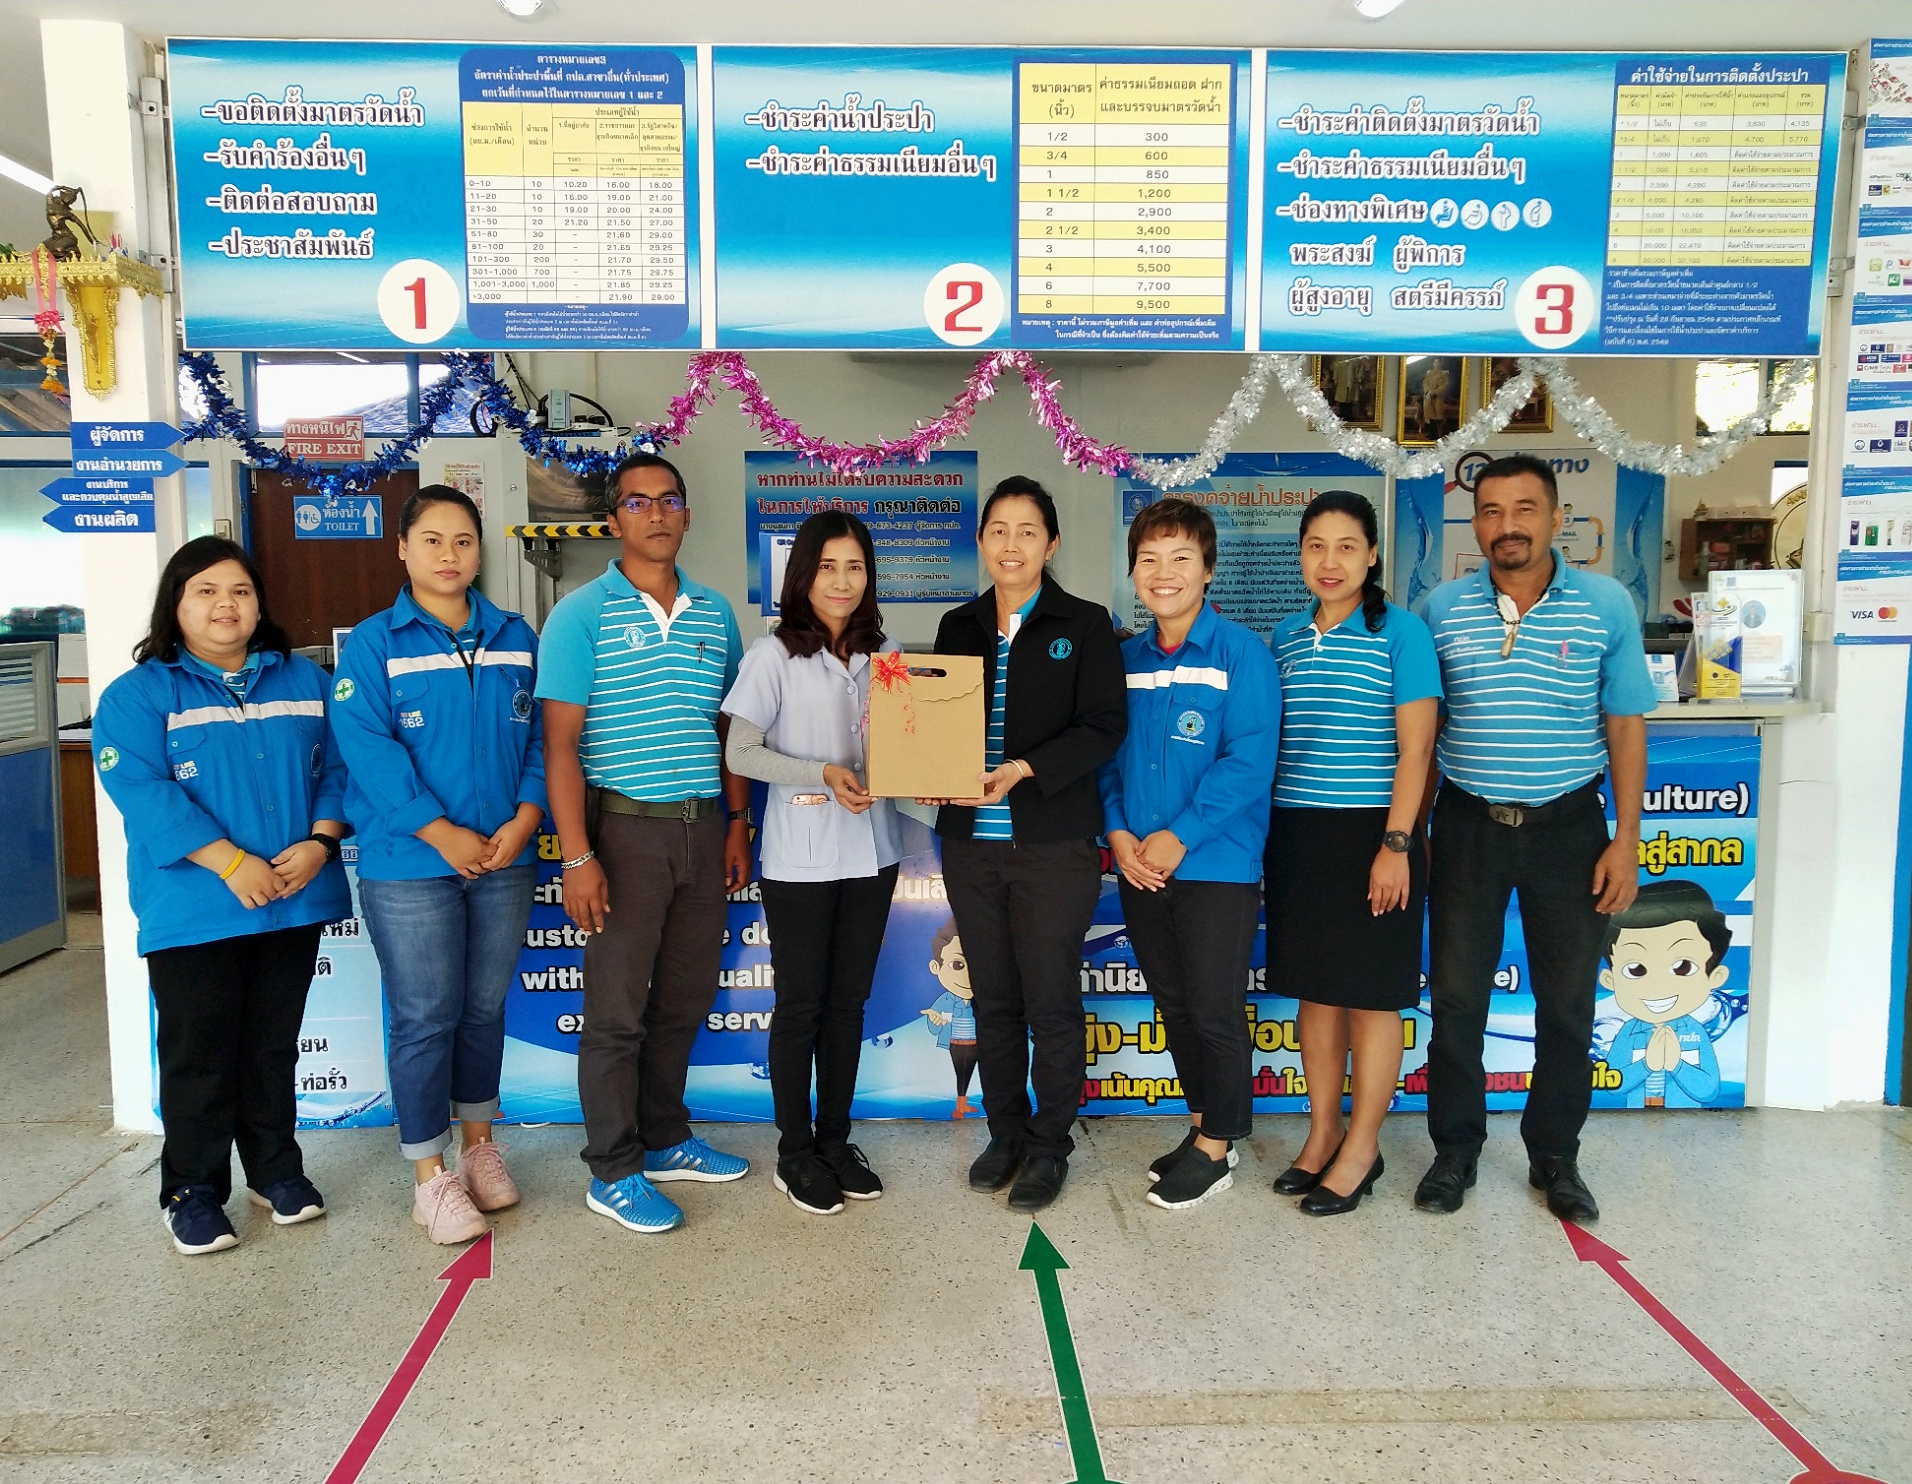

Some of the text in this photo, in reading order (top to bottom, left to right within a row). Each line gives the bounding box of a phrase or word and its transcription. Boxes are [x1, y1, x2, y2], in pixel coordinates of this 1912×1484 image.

[1631, 62, 1809, 83] ค่าใช้จ่ายในการติดตั้งประปา
[1032, 83, 1092, 94] ขนาดมาตร
[748, 96, 932, 130] -ชำระค่าน้ำประปา
[1048, 99, 1075, 118] (นิ้ว)
[1281, 99, 1538, 133] -ชำระค่าติดตั้งมาตรวัดน้ำ
[1047, 132, 1067, 142] 1/2
[1145, 133, 1168, 142] 300
[1047, 151, 1067, 161] 3/4
[1145, 151, 1168, 161] 600
[1047, 170, 1052, 179] 1
[1146, 170, 1169, 179] 850
[1138, 189, 1171, 199] 1,200
[210, 188, 374, 212] -ติดต่อสอบถาม
[1046, 207, 1053, 216] 2
[1138, 207, 1171, 218] 2,900
[1278, 195, 1425, 221] -ช่องทางพิเศษ
[1046, 226, 1053, 235] 2
[1137, 226, 1170, 236] 3,400
[211, 229, 373, 256] -ประชาสัมพันธ์
[1046, 244, 1053, 253] 3
[1137, 245, 1171, 255] 4,100
[1292, 238, 1464, 271] พระสงฆ์ ผู้พิการ
[1045, 263, 1052, 271] 4
[1137, 263, 1171, 273] 5,500
[1046, 281, 1052, 290] 6
[1138, 282, 1171, 292] 7,700
[1291, 279, 1370, 314] ผู้สูงอายุ
[404, 278, 426, 329] 1
[944, 281, 983, 332] 2
[1046, 300, 1052, 309] 8
[1137, 300, 1170, 310] 9,500
[1535, 283, 1574, 334] 3
[286, 420, 346, 435] ทางหนีไฟ
[90, 426, 144, 446] ผู้จัดการ
[288, 443, 361, 455] FIRE EXIT
[76, 457, 163, 471] งานอำนวยการ
[874, 497, 961, 519] กรุณาติดต่อ
[75, 510, 139, 526] งานผลิต
[324, 523, 359, 531] TOILET
[1851, 610, 1874, 619] VISA
[1643, 783, 1749, 814] ulture)
[523, 925, 588, 946] usto
[718, 964, 774, 987] uali
[707, 1010, 775, 1030] serv
